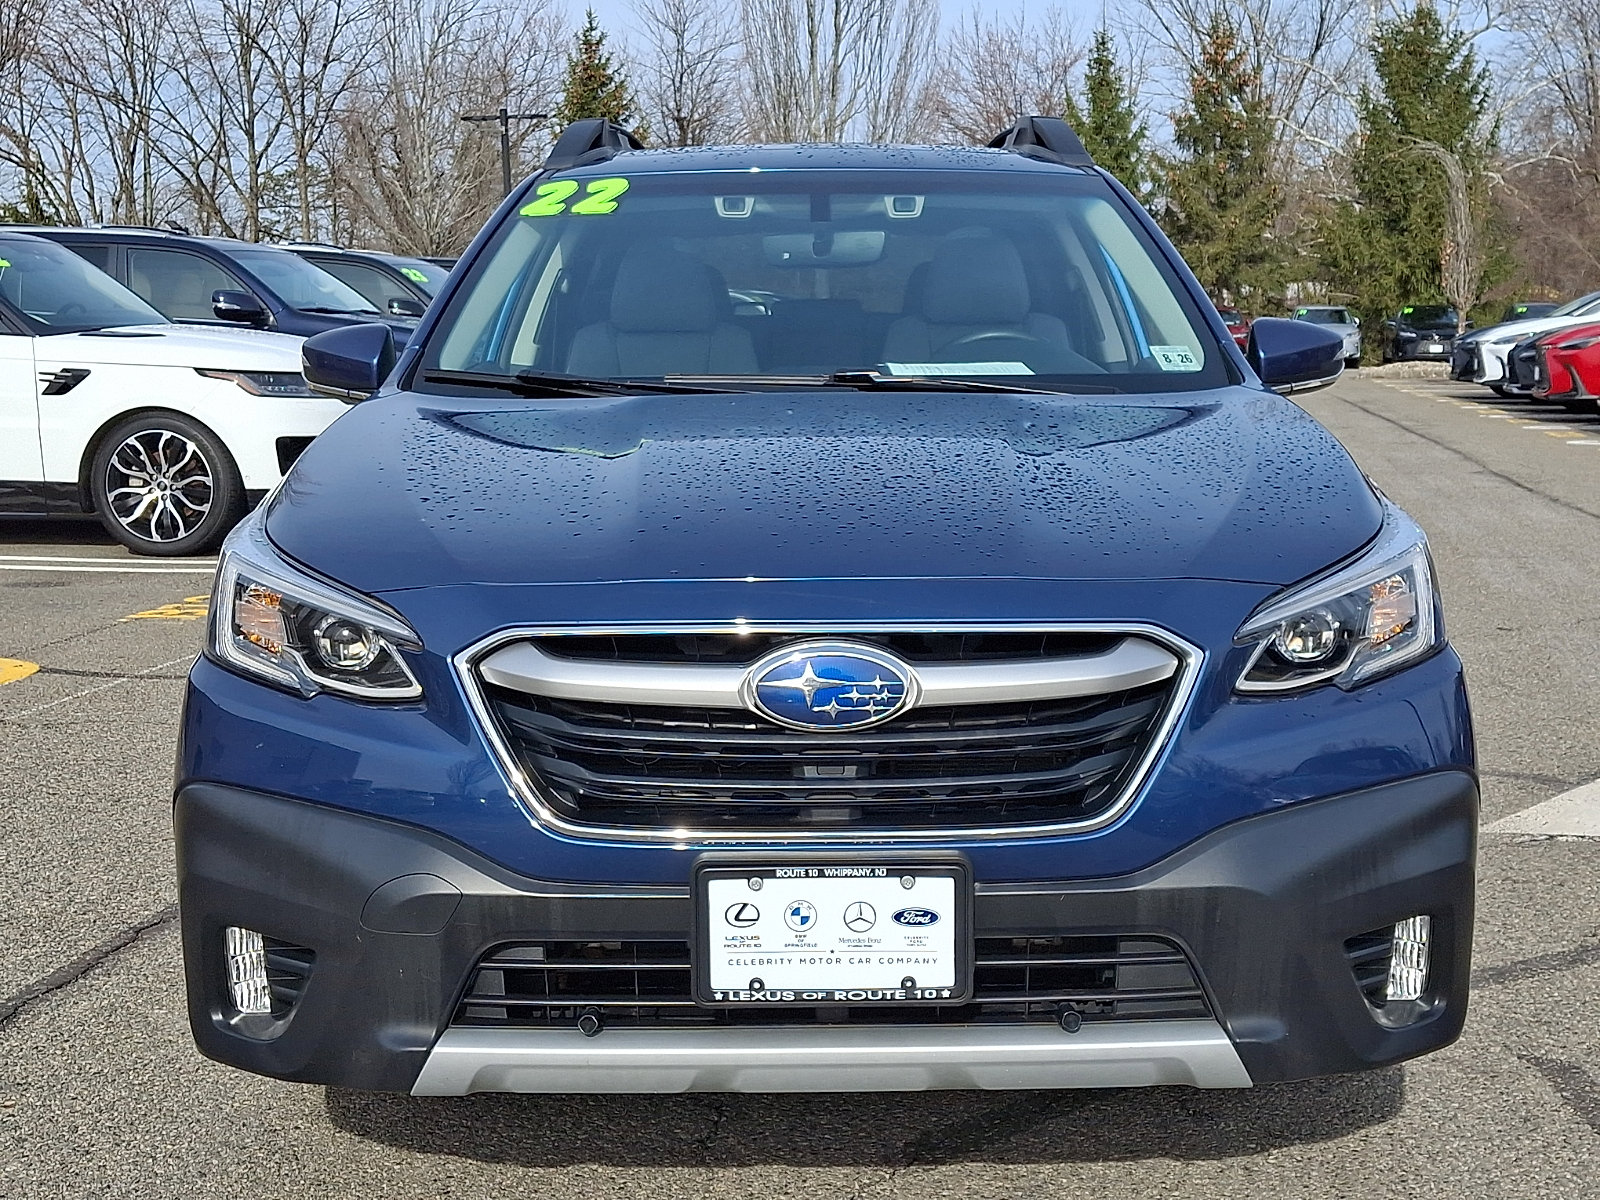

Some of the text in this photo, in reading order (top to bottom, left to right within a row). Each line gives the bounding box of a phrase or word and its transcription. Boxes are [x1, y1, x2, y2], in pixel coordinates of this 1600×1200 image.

[520, 179, 629, 216] 22
[1162, 353, 1193, 364] 8 26
[776, 868, 806, 878] ROUTE
[808, 868, 819, 878] 10
[875, 867, 887, 876] NJ
[901, 911, 931, 923] Ford
[728, 956, 938, 966] CELEBRITY MOTOR CAR COMPANY
[729, 990, 795, 1001] LEXUS
[835, 990, 906, 1000] ROUTE
[913, 988, 937, 999] 10
